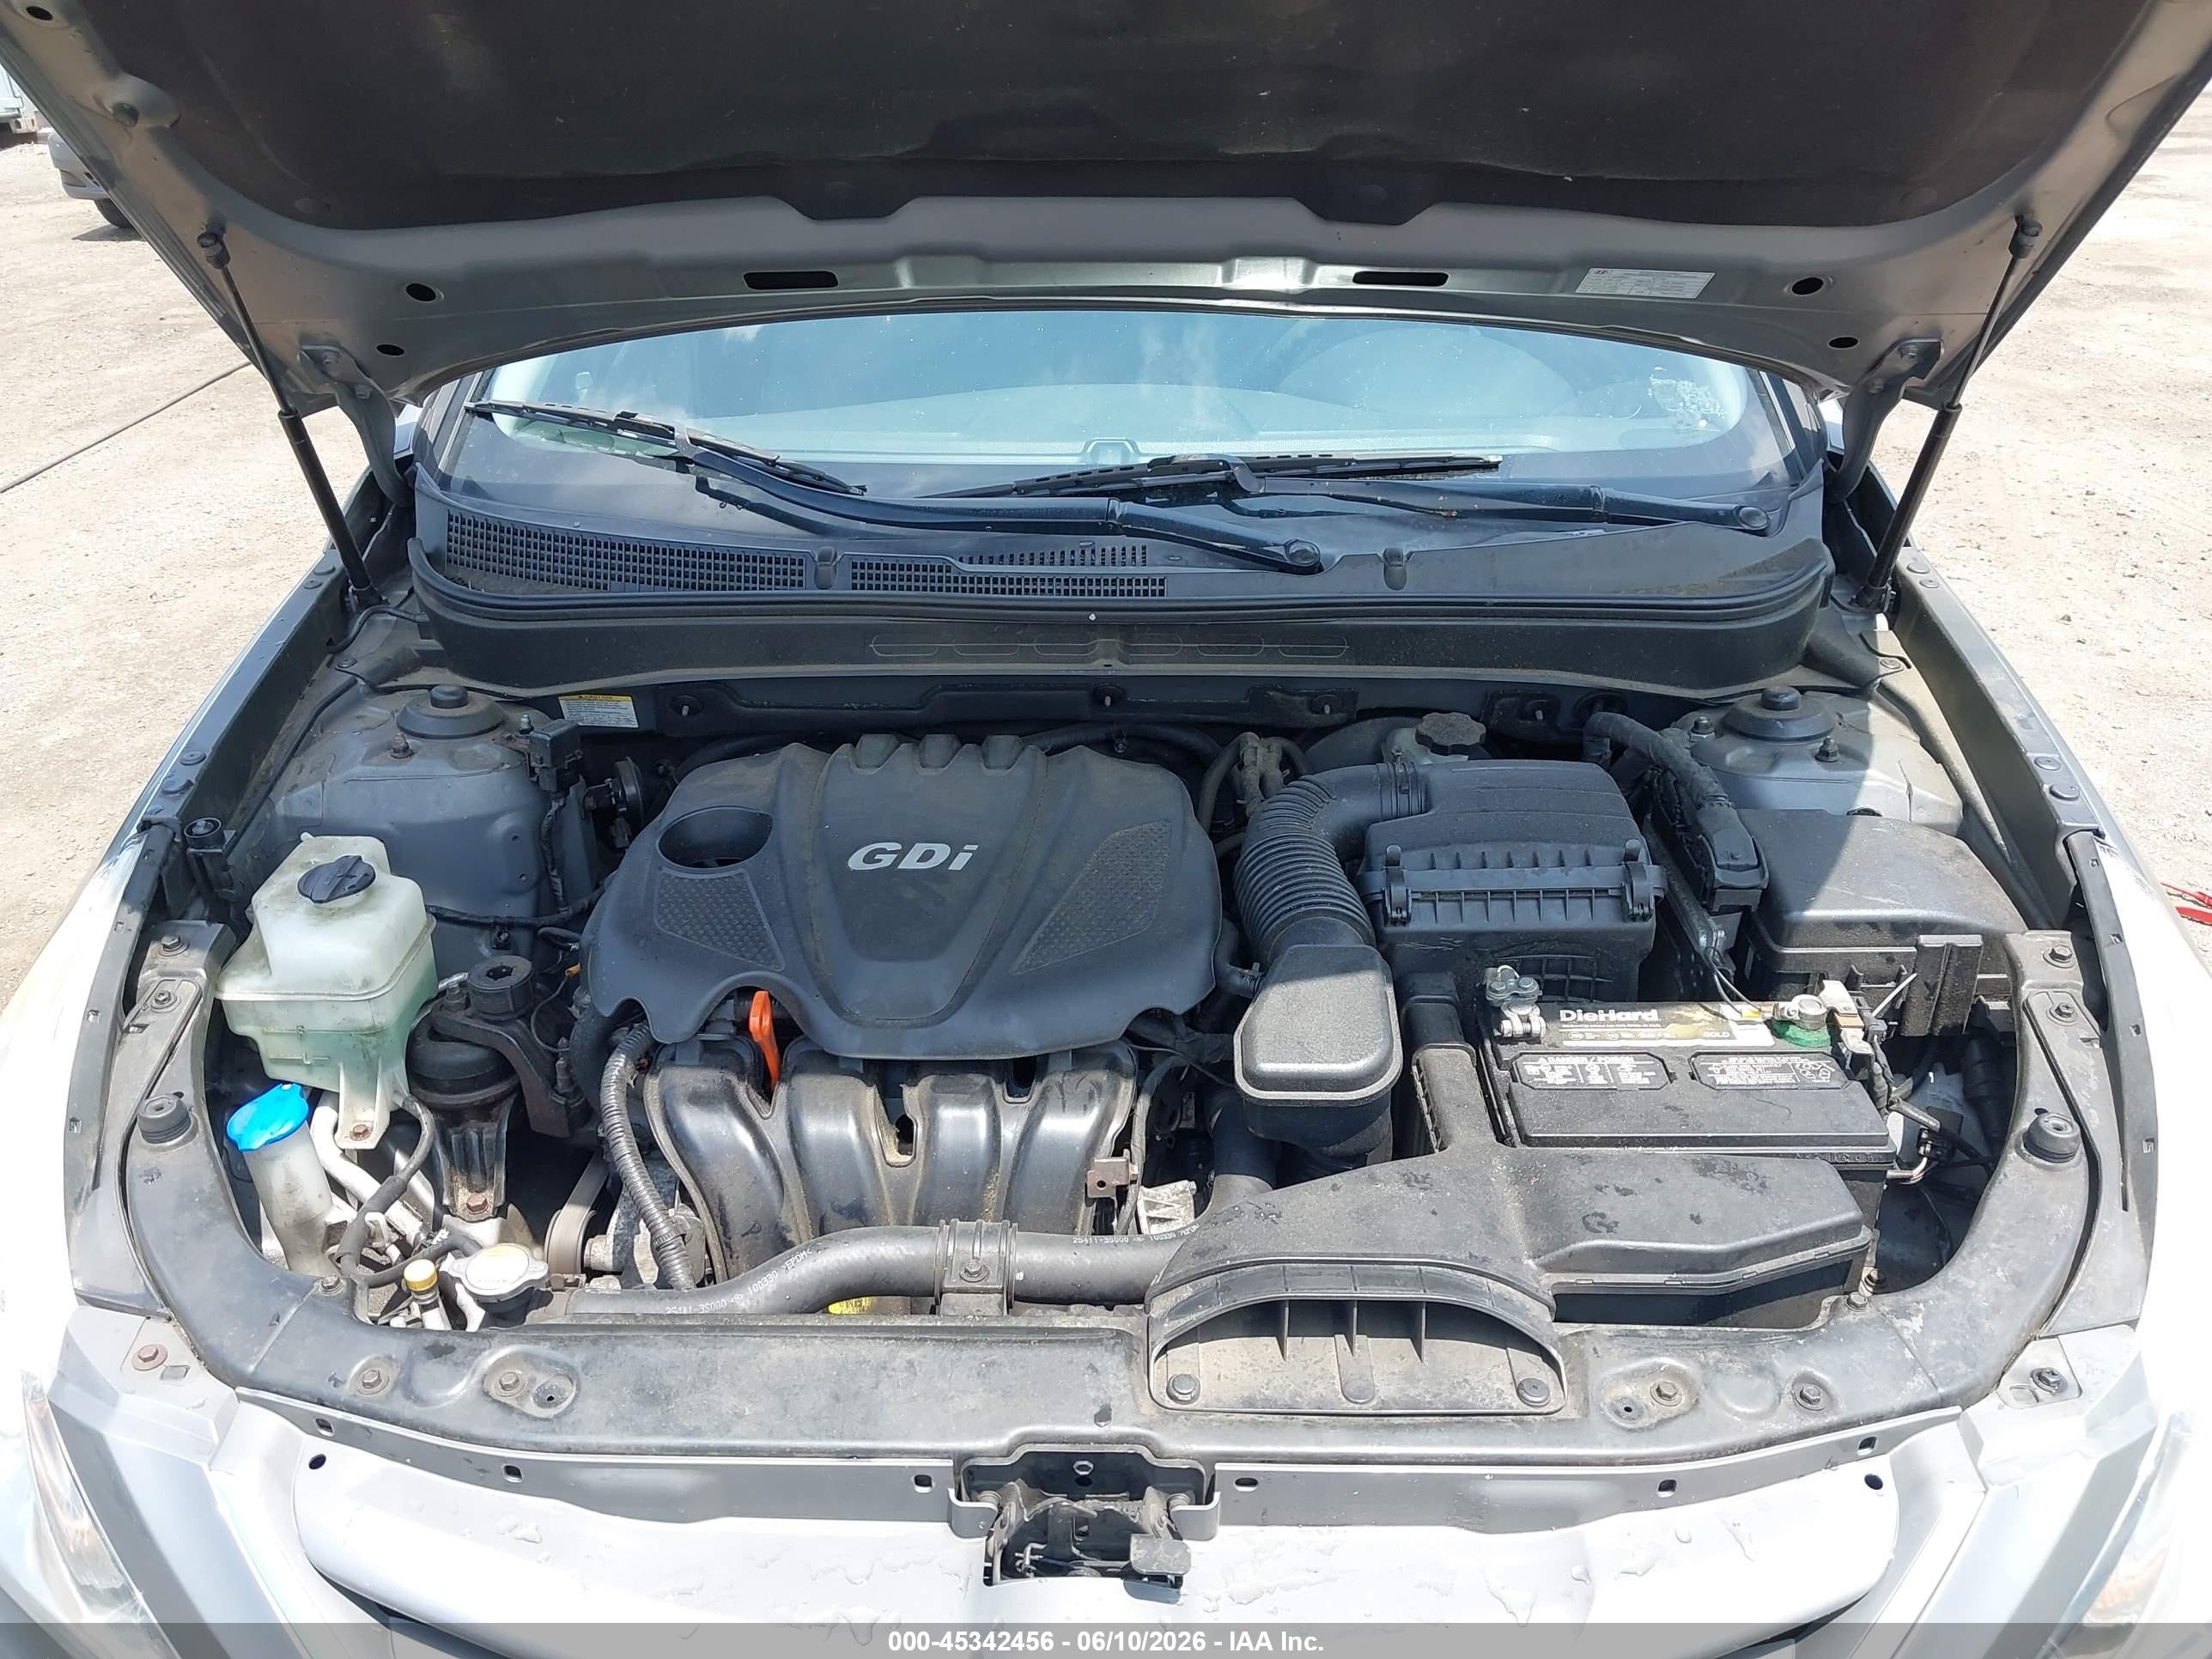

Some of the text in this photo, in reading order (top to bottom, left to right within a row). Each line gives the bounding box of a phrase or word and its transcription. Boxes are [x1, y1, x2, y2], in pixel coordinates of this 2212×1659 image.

[848, 842, 979, 871] GDi
[1559, 1009, 1659, 1022] DieHard
[748, 1270, 779, 1296] 100330
